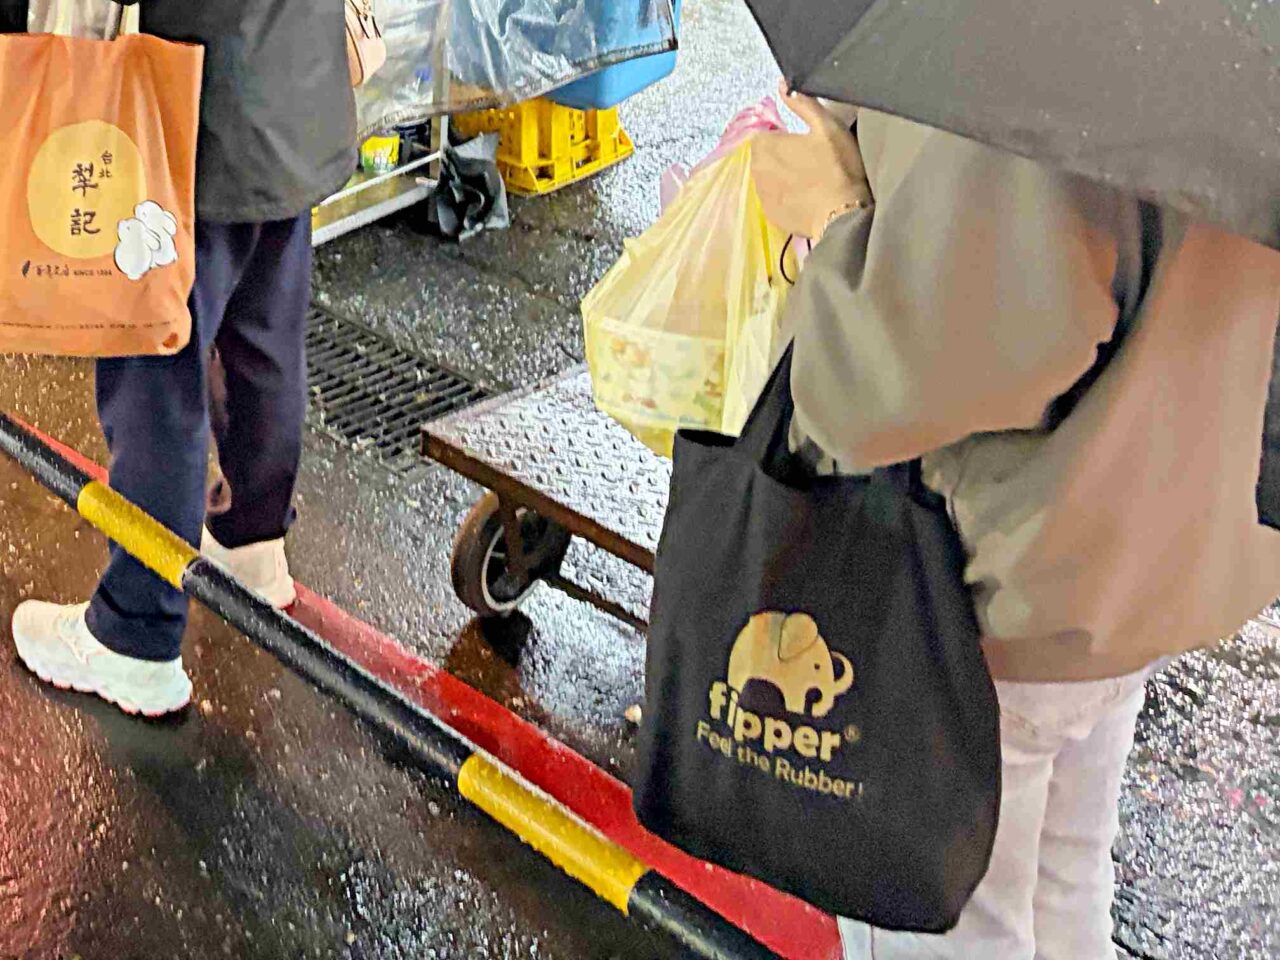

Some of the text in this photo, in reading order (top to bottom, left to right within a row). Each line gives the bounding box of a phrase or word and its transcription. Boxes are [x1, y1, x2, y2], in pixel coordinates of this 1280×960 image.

[99, 150, 113, 178] 台北
[696, 720, 733, 758] Feel
[737, 746, 770, 772] the
[709, 681, 841, 762] fipper
